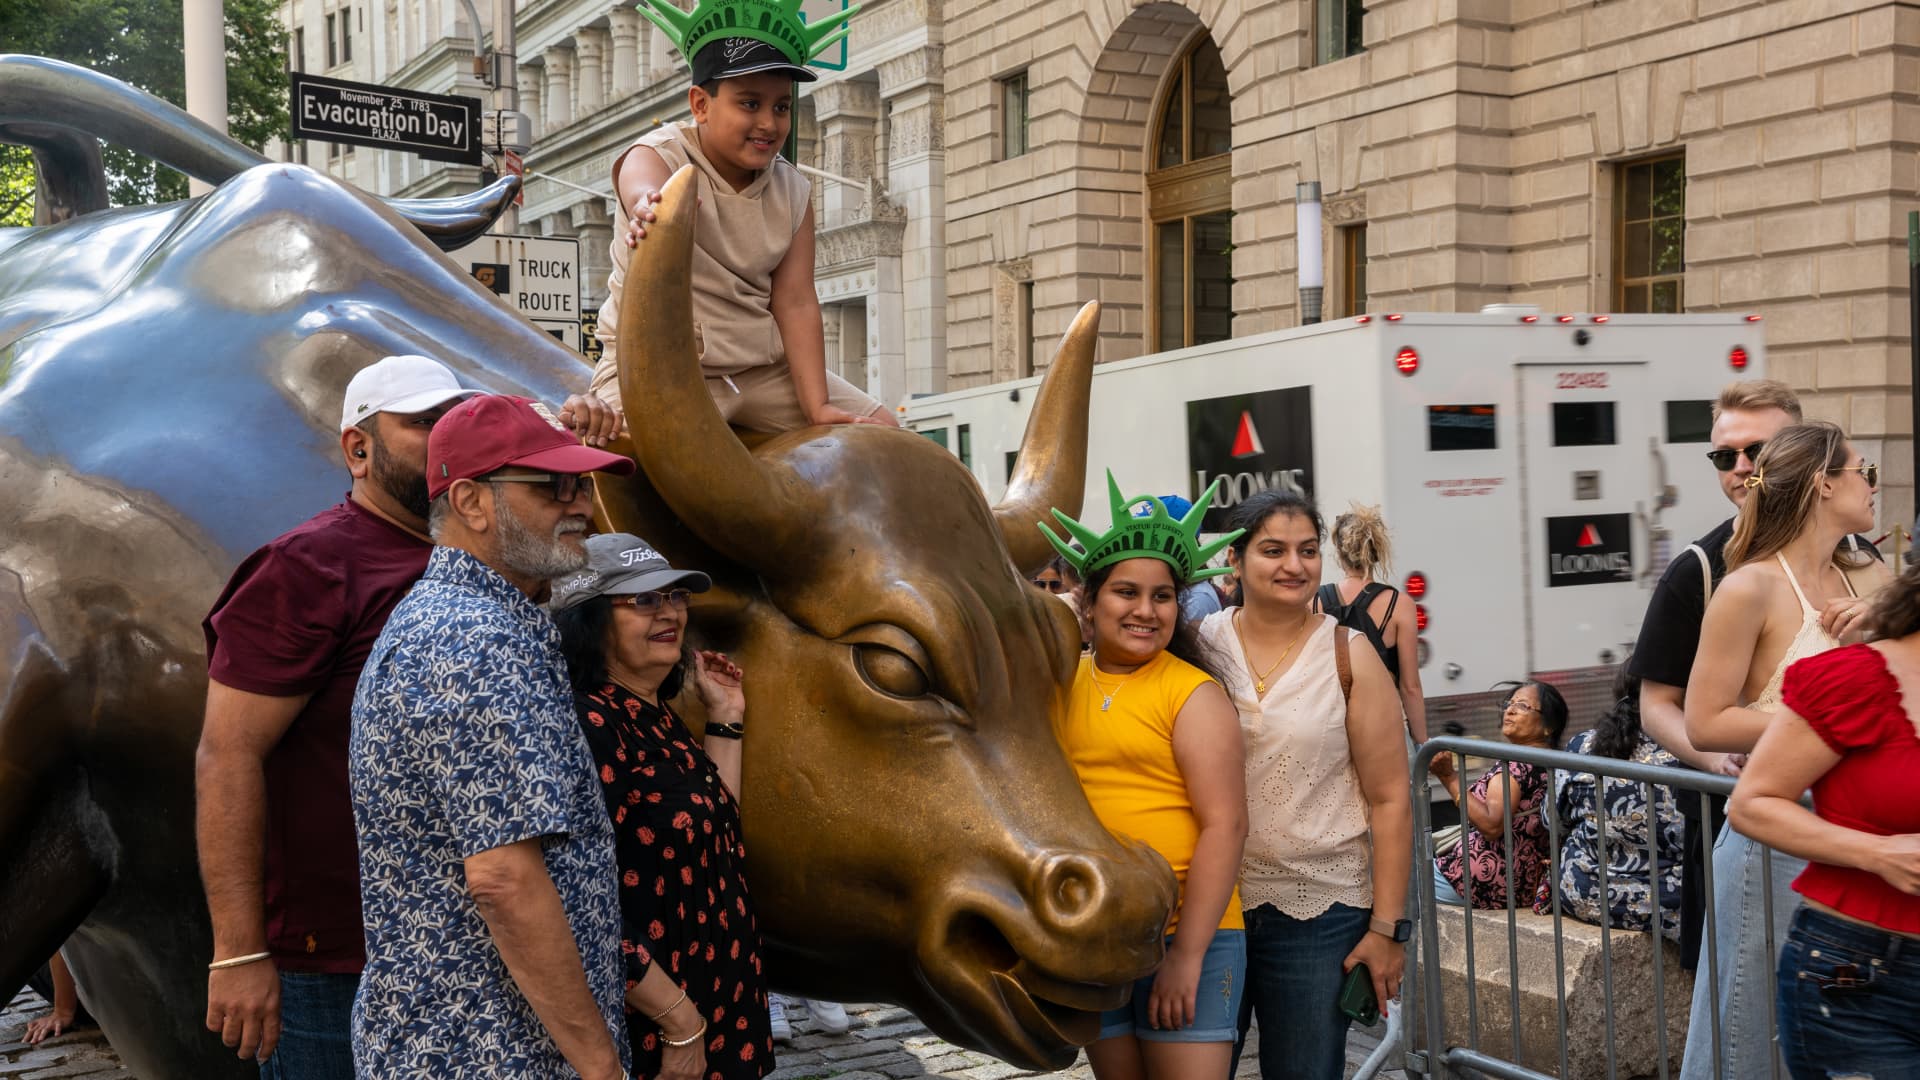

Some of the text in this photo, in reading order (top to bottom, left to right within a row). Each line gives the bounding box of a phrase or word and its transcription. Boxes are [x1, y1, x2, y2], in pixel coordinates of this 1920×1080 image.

[340, 90, 385, 106] November
[410, 100, 430, 113] 1783
[304, 95, 463, 144] Evacuation Day
[372, 128, 400, 141] PLAZA
[518, 259, 571, 279] TRUCK
[518, 292, 572, 312] ROUTE
[619, 547, 669, 567] Title
